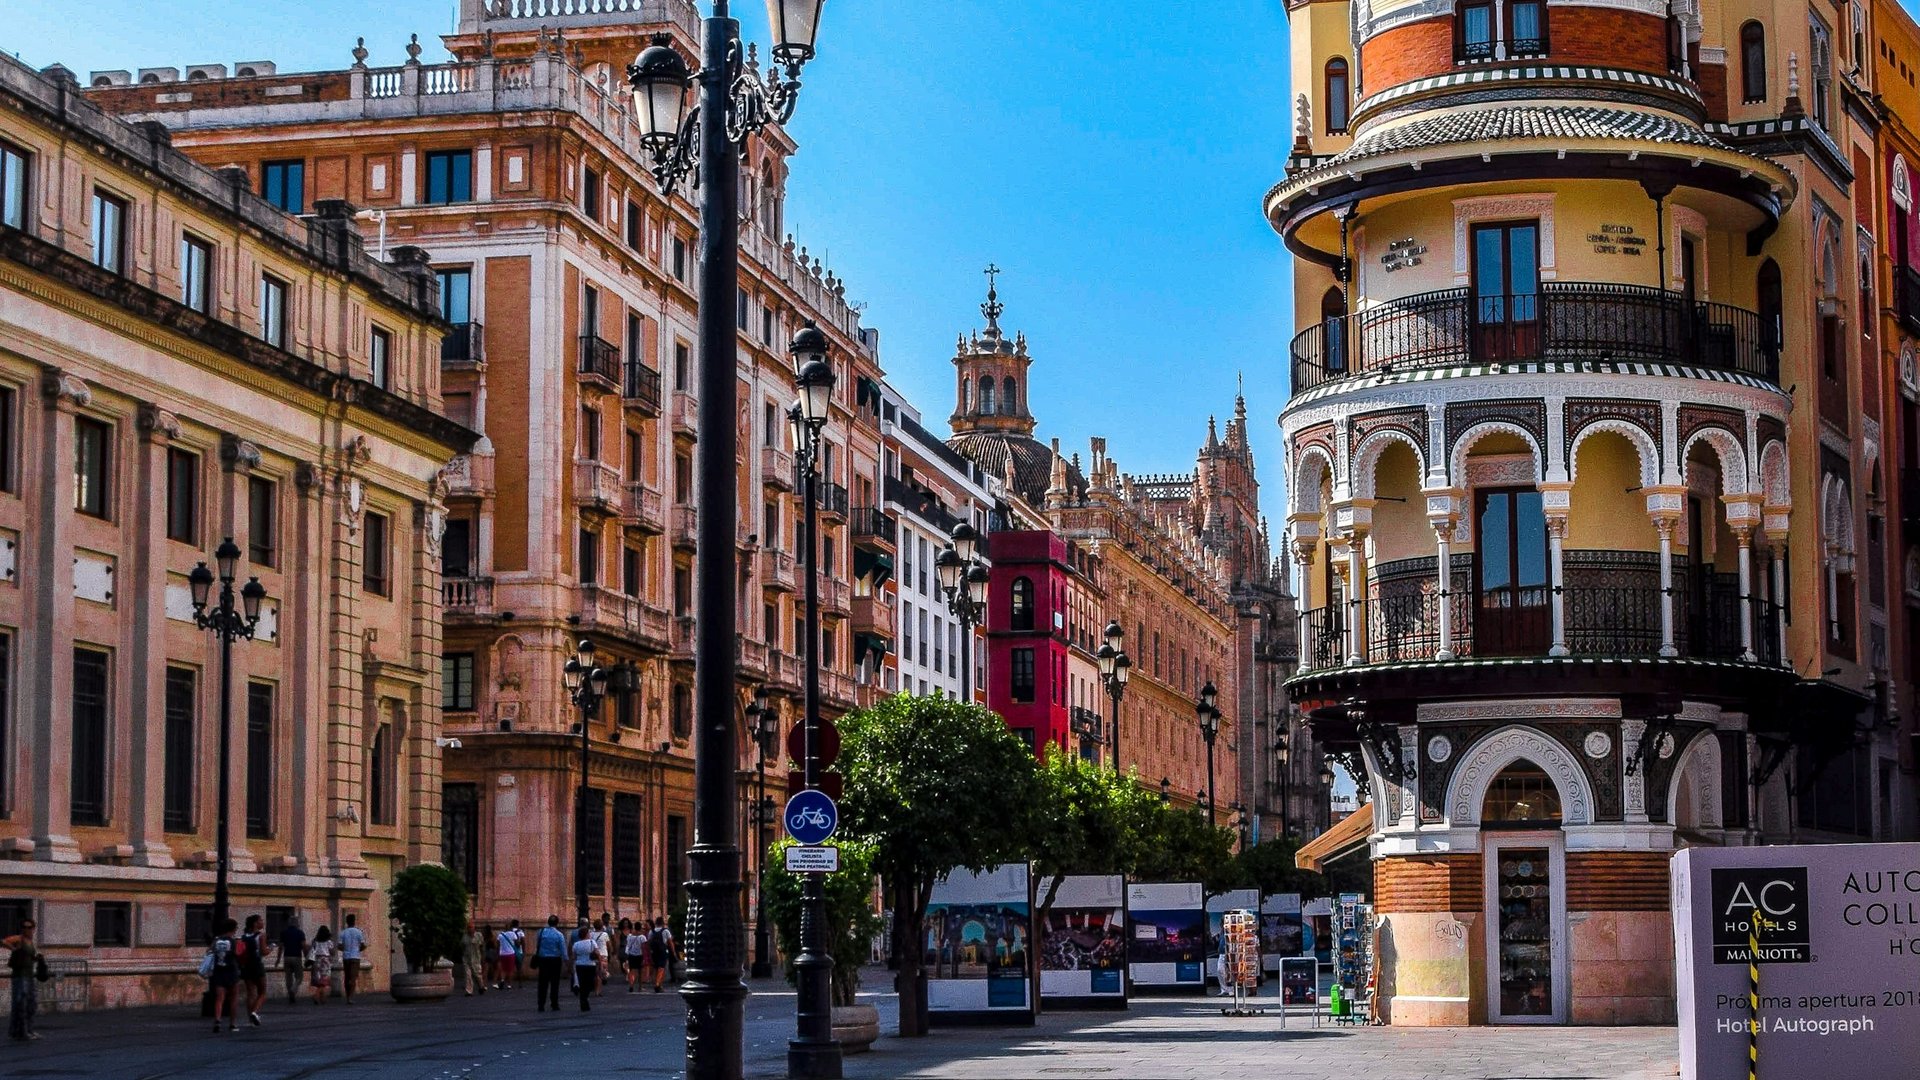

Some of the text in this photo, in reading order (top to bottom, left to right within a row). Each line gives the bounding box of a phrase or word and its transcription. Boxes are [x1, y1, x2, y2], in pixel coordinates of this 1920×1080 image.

[1842, 870, 1920, 894] AUTO
[1725, 880, 1796, 915] AC
[1843, 902, 1919, 926] COLL
[1725, 921, 1797, 932] HOLS
[1798, 993, 1876, 1011] apertura
[1883, 991, 1920, 1008] 201
[1773, 1015, 1875, 1036] Autograph
